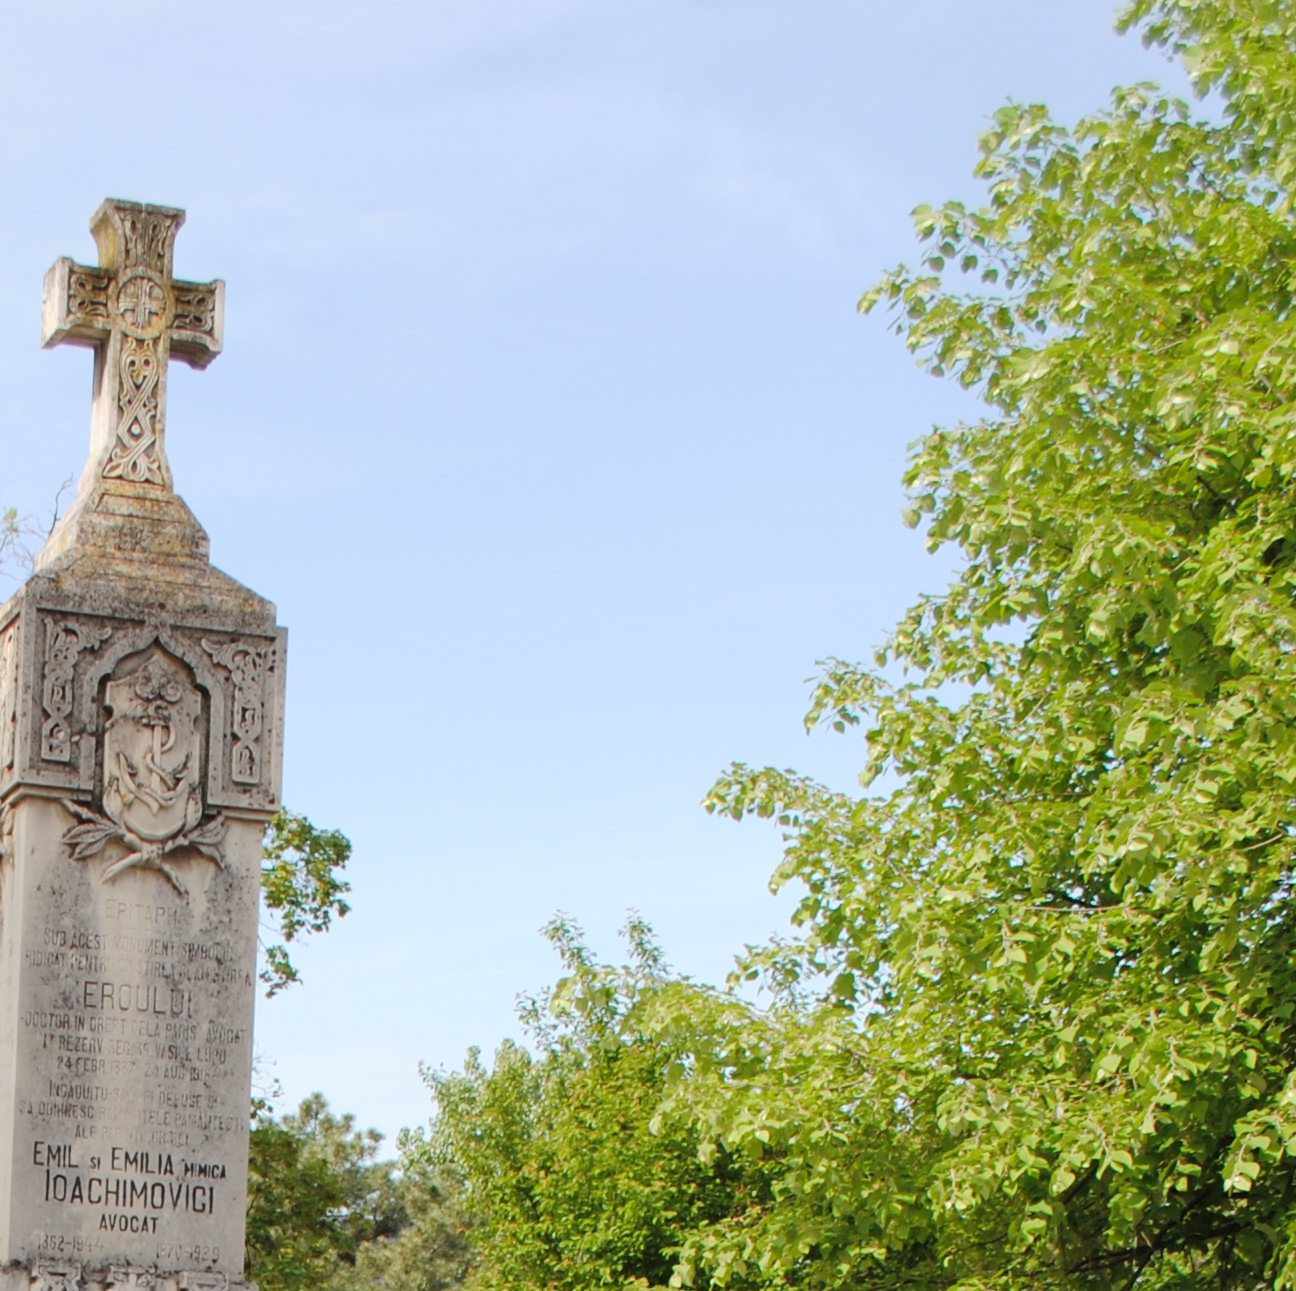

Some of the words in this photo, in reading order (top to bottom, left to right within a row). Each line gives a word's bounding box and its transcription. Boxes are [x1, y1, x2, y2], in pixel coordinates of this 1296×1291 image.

[83, 979, 194, 1019] EROULUI
[33, 1139, 80, 1169] EMIL
[111, 1146, 175, 1177] EMILIA
[184, 1162, 227, 1180] MIMICA
[44, 1167, 215, 1214] IOACHIMOVICI
[98, 1213, 160, 1235] AVOCAT
